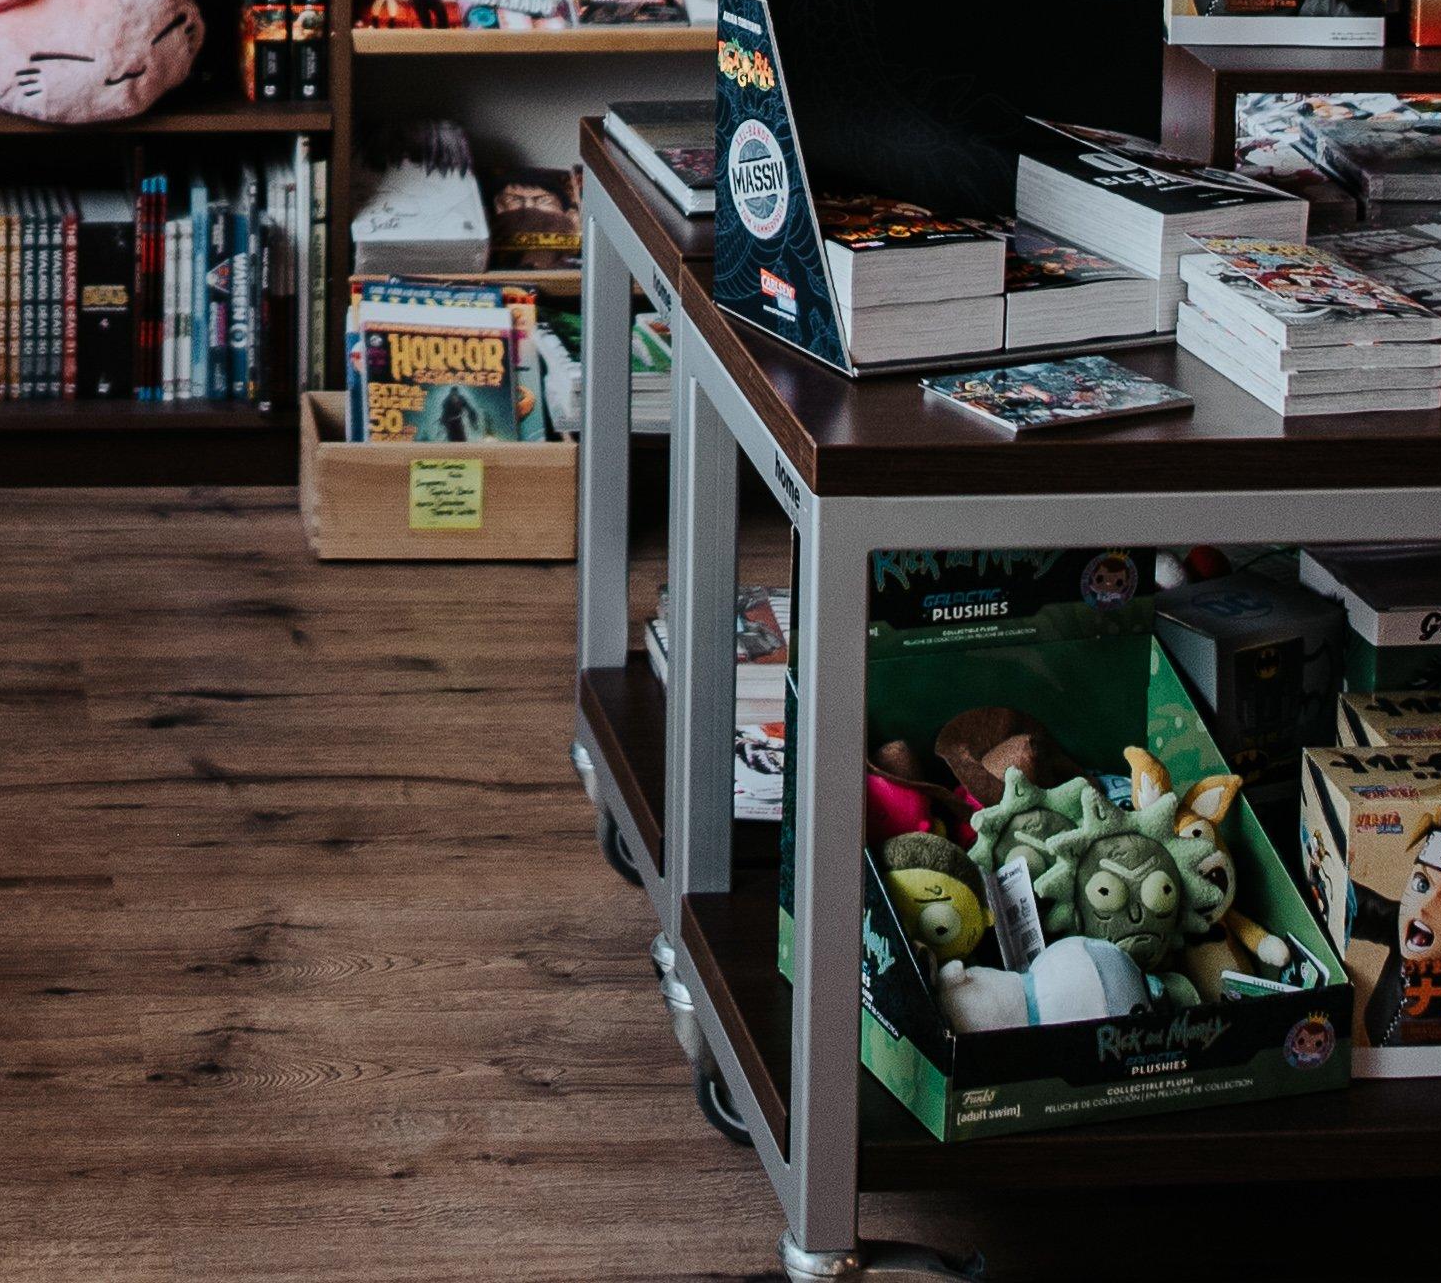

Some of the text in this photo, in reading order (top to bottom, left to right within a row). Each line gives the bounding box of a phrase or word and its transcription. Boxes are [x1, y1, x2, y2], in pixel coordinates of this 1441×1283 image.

[731, 161, 785, 196] MASSIV
[389, 334, 505, 380] HORROR
[370, 410, 404, 433] 50
[773, 449, 802, 509] home
[931, 601, 1010, 622] PLUSHIES
[1130, 1059, 1188, 1077] PLUSHIES
[1165, 1076, 1195, 1088] PLUSH
